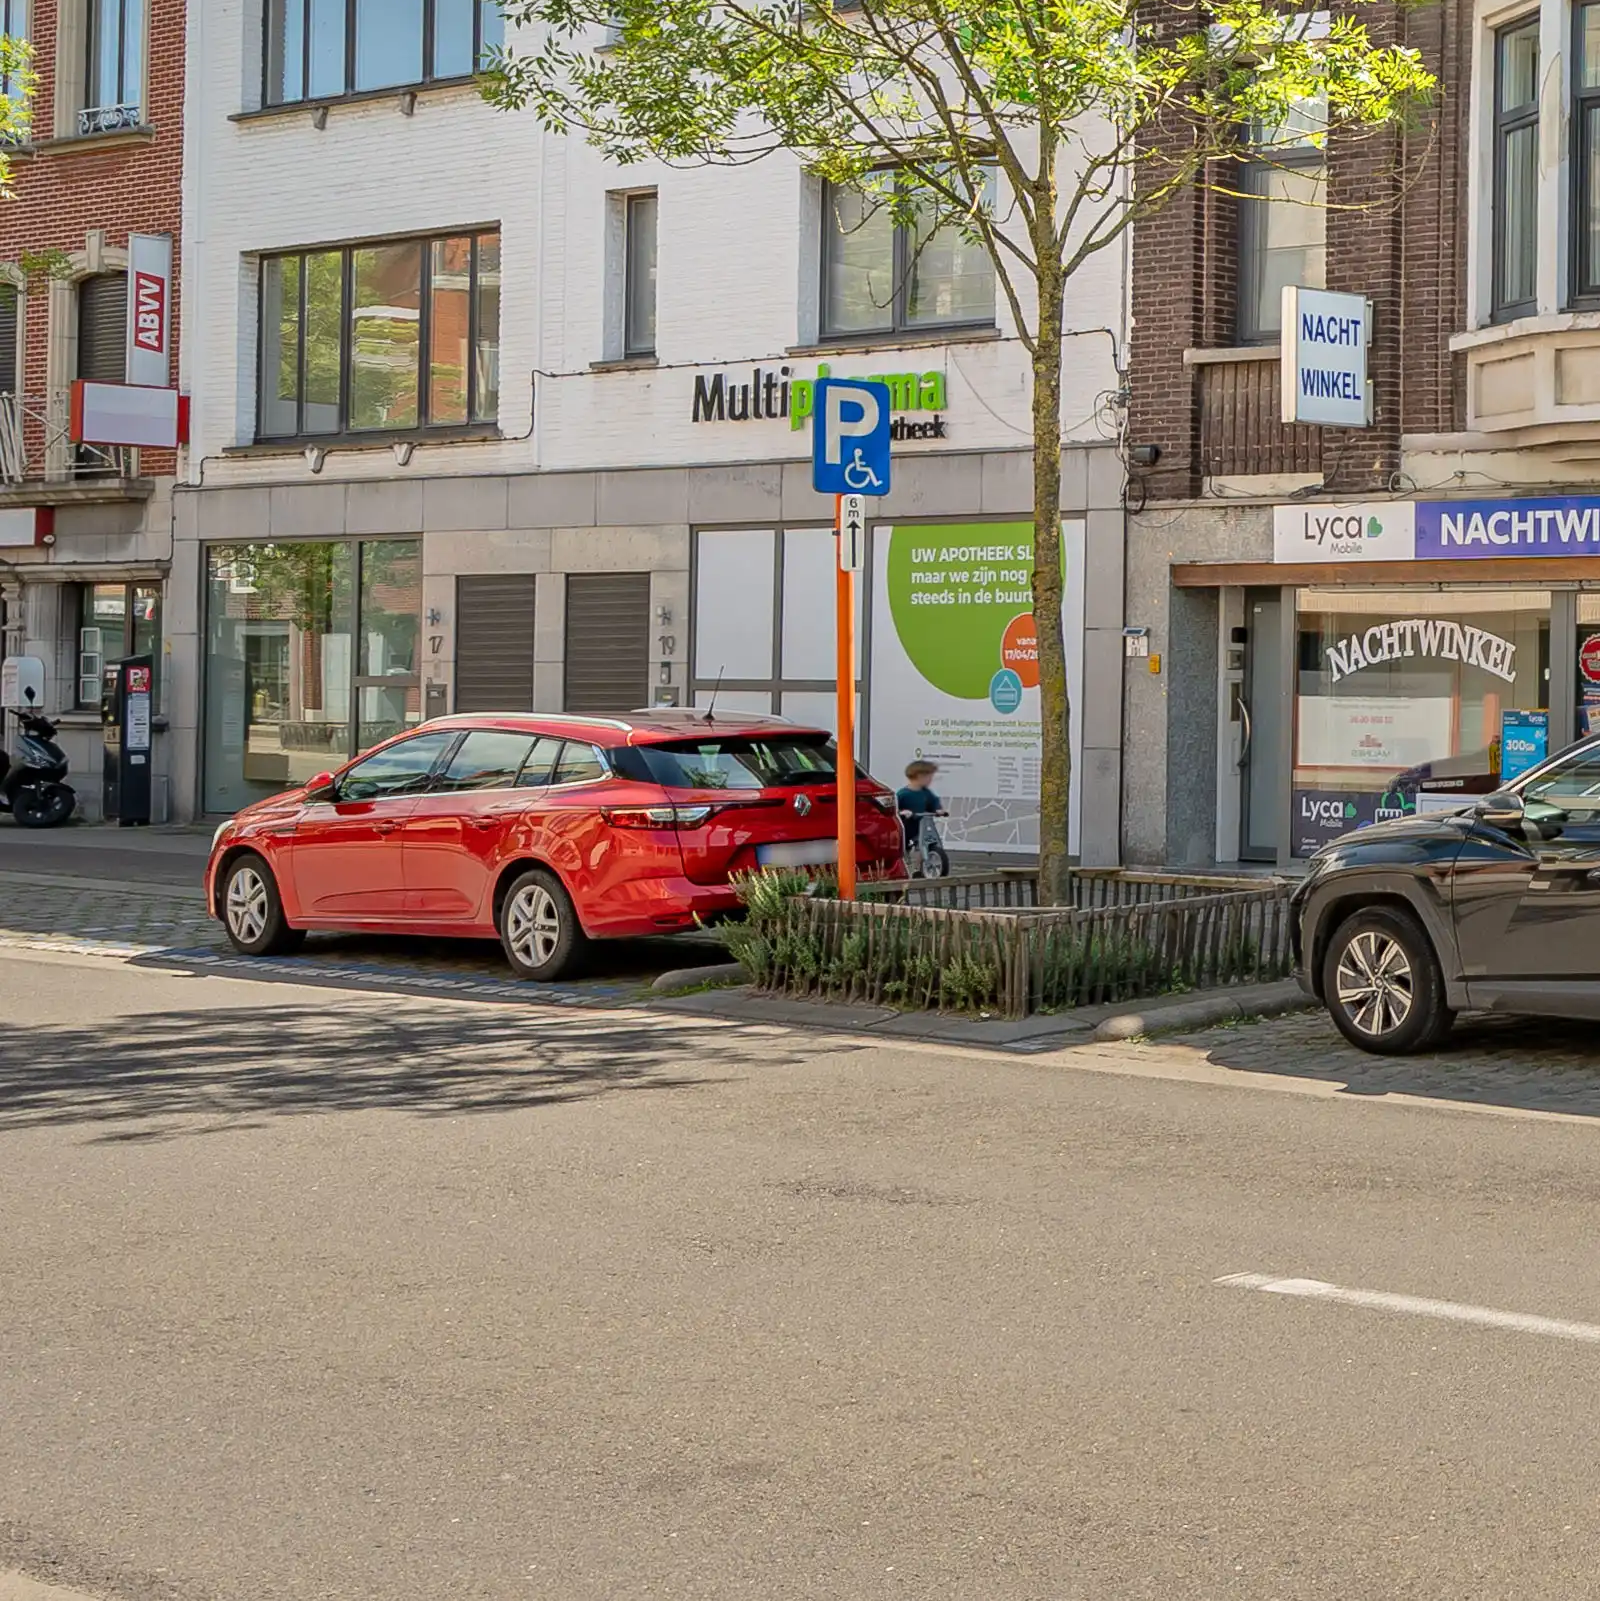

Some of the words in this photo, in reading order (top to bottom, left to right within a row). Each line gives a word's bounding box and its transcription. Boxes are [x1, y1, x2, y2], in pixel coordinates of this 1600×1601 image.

[138, 277, 160, 348] ABVV
[1302, 313, 1361, 347] NACHT
[1301, 368, 1361, 401] WINKEL
[692, 363, 947, 432] Multipma
[825, 386, 880, 465] P
[849, 497, 858, 508] 6
[848, 509, 860, 519] m
[1304, 511, 1363, 547] Lyca
[911, 548, 936, 563] UW
[939, 546, 1014, 562] APOTHEEK
[1329, 541, 1363, 555] Mobile
[911, 571, 945, 584] maar
[949, 571, 969, 583] we
[972, 566, 997, 585] zijn
[1000, 569, 1027, 585] nog
[911, 589, 955, 605] steeds
[957, 588, 971, 604] in
[974, 588, 993, 603] de
[428, 635, 444, 654] 17
[657, 635, 676, 656] 19
[1016, 638, 1037, 646] vana
[1326, 619, 1516, 683] NACHTWINKEL
[1302, 796, 1344, 822] Lyca
[1319, 818, 1344, 829] Mobile
